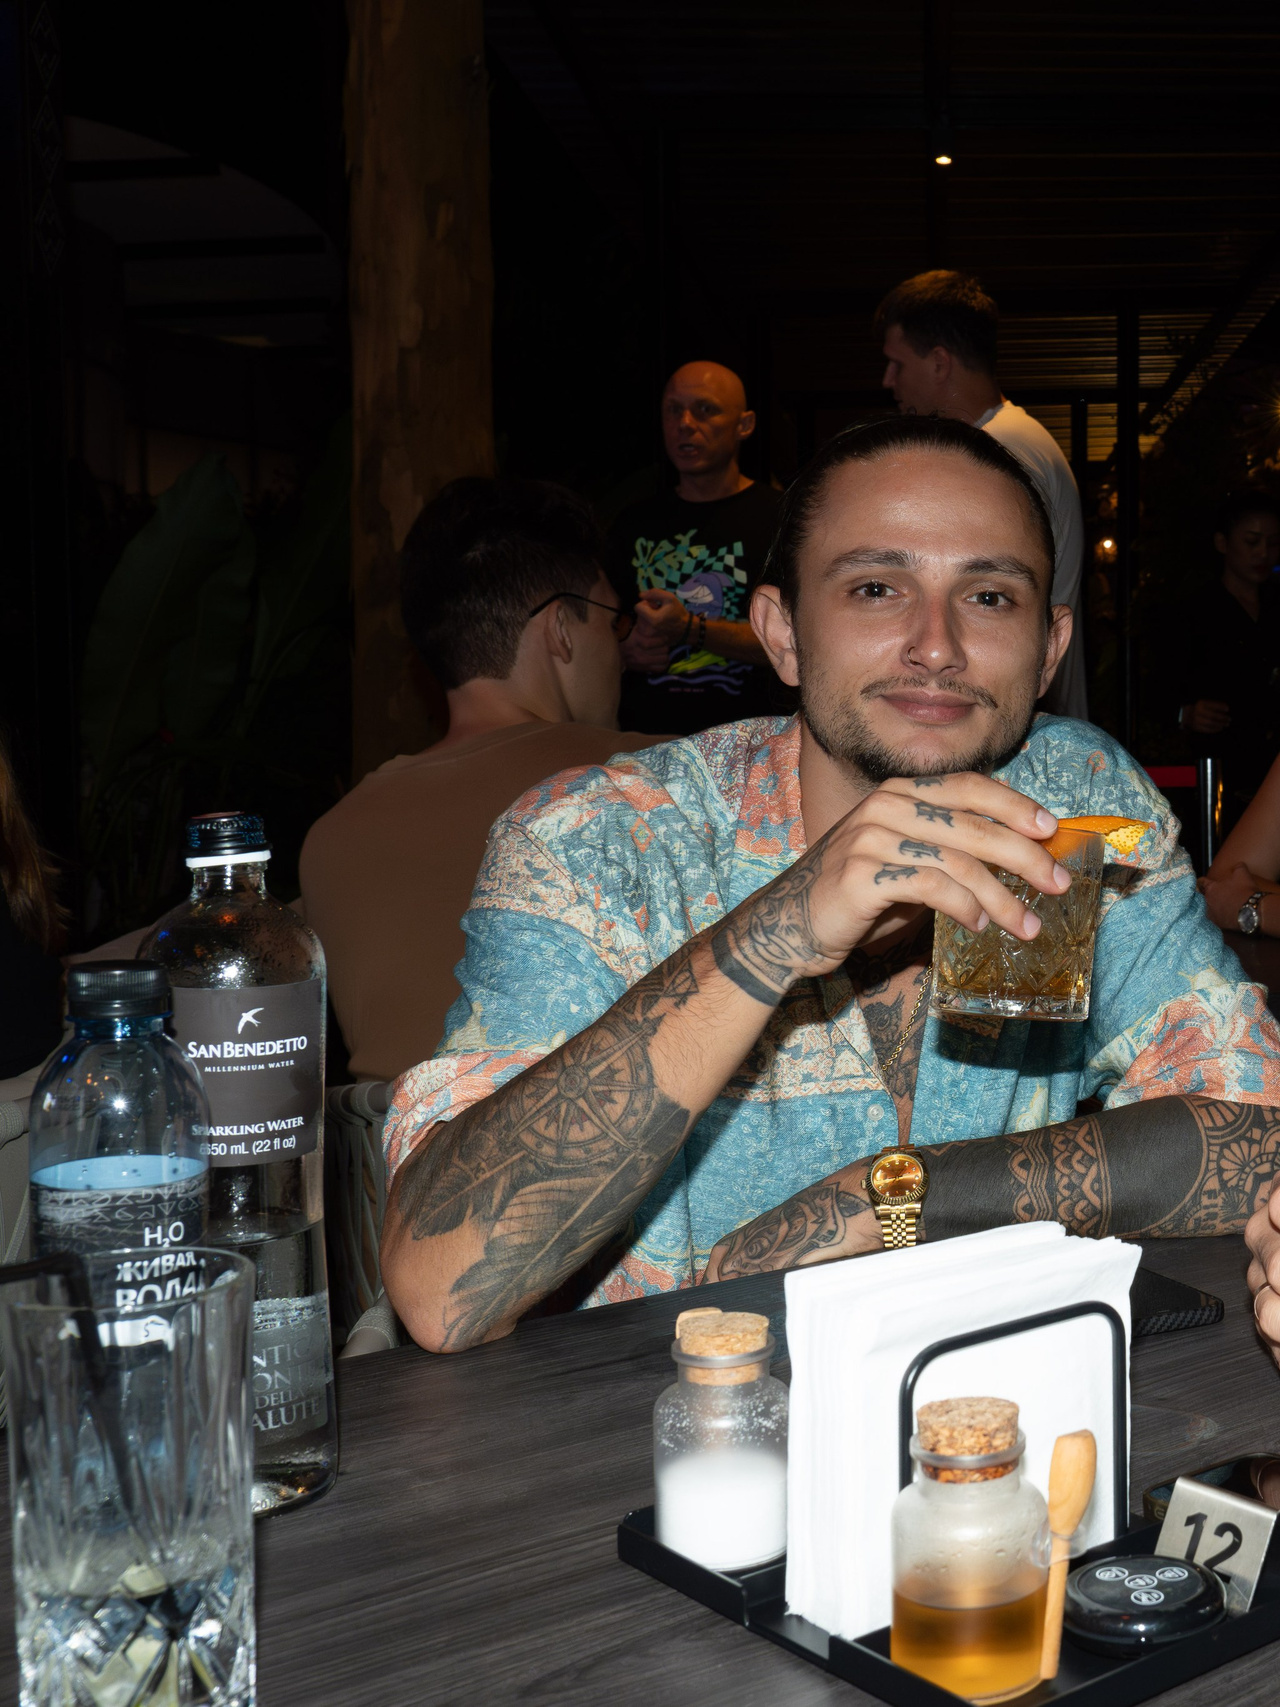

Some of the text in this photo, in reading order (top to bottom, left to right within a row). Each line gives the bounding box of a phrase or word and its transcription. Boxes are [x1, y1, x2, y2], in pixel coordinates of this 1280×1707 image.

[204, 1059, 295, 1073] MILLENNIUM WATER
[266, 1116, 305, 1132] WATER
[230, 1142, 249, 1155] mL
[252, 1139, 271, 1156] (22
[273, 1137, 281, 1150] fl
[282, 1135, 297, 1150] oz)
[116, 1251, 198, 1282] ЖИВАЯ
[251, 1396, 322, 1432] ALUTE
[1184, 1512, 1243, 1583] 12
